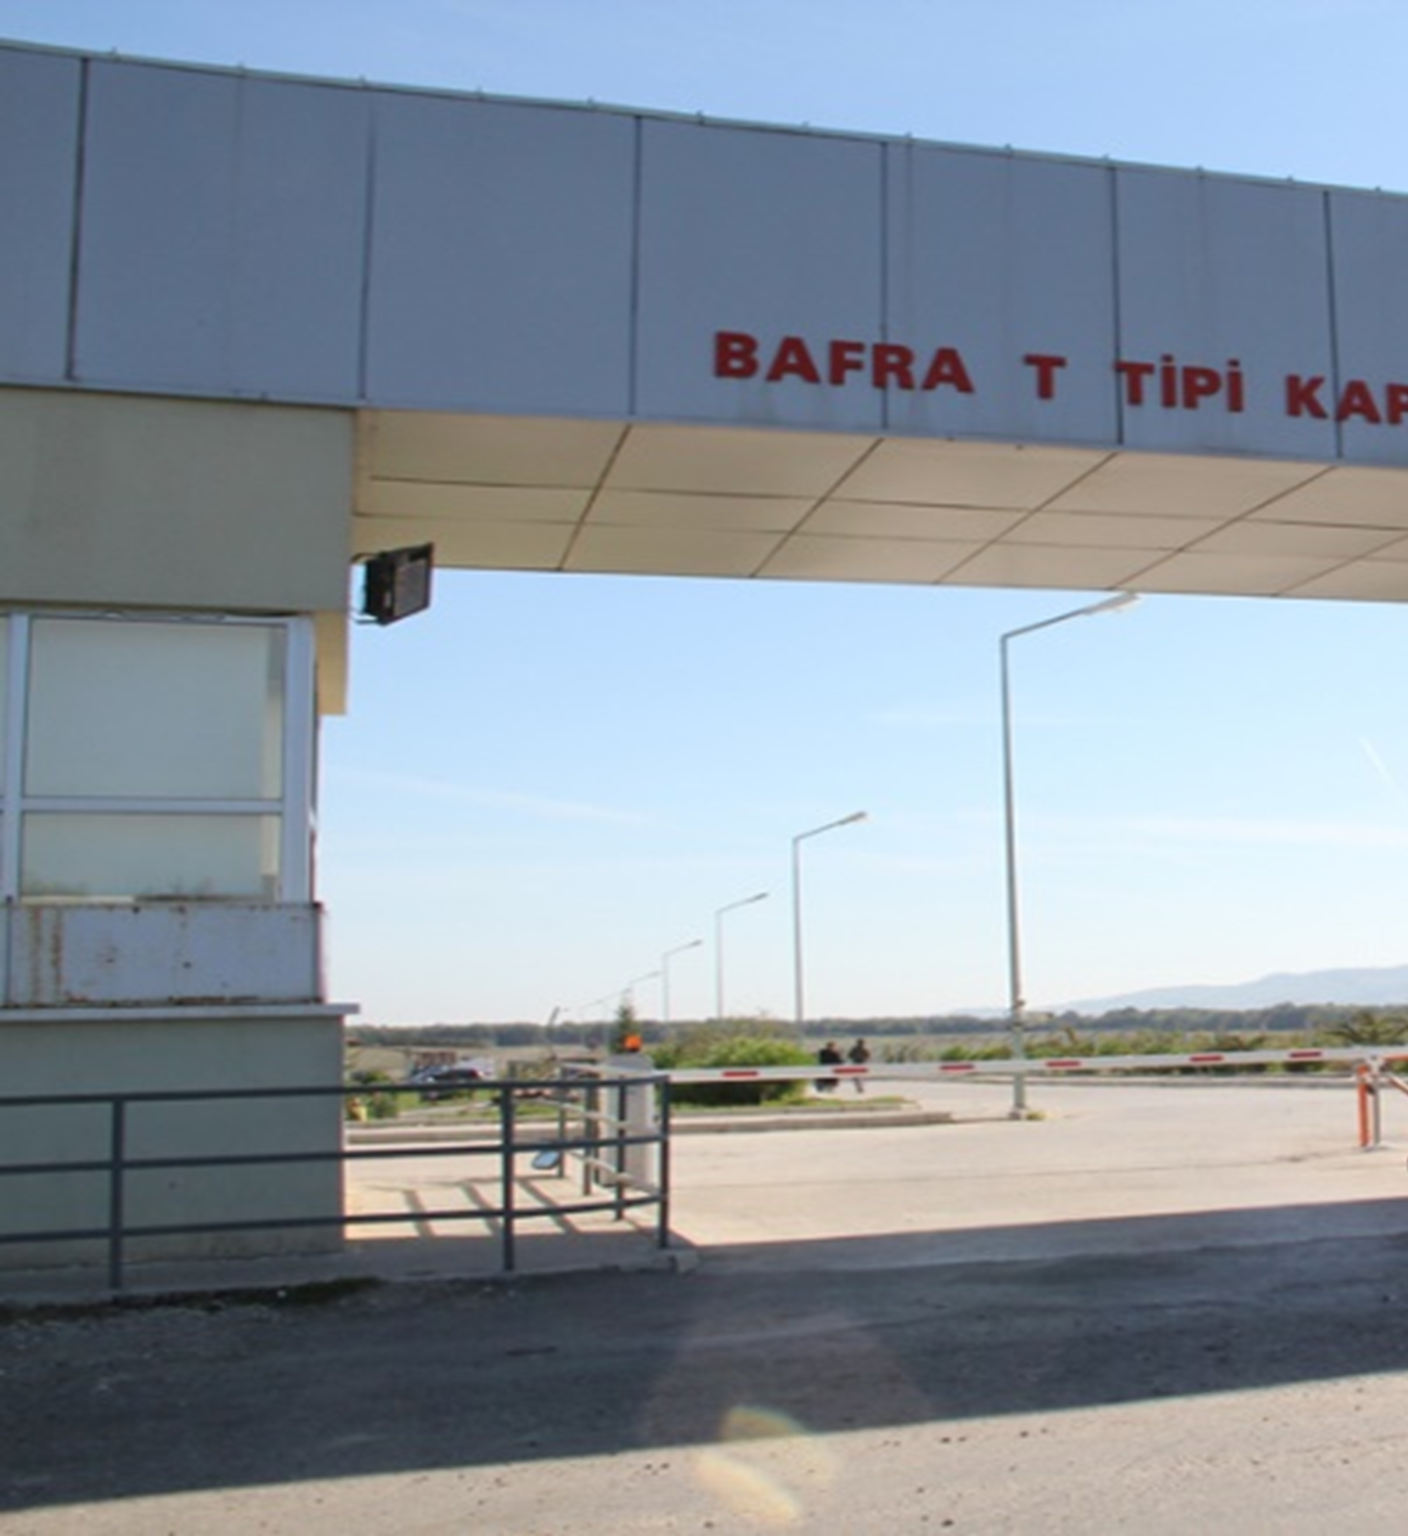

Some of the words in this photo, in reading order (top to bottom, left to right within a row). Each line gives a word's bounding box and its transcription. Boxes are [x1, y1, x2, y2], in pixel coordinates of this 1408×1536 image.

[713, 331, 973, 394] BAFRA
[1025, 354, 1067, 400] T
[1115, 354, 1245, 413] TİPİ
